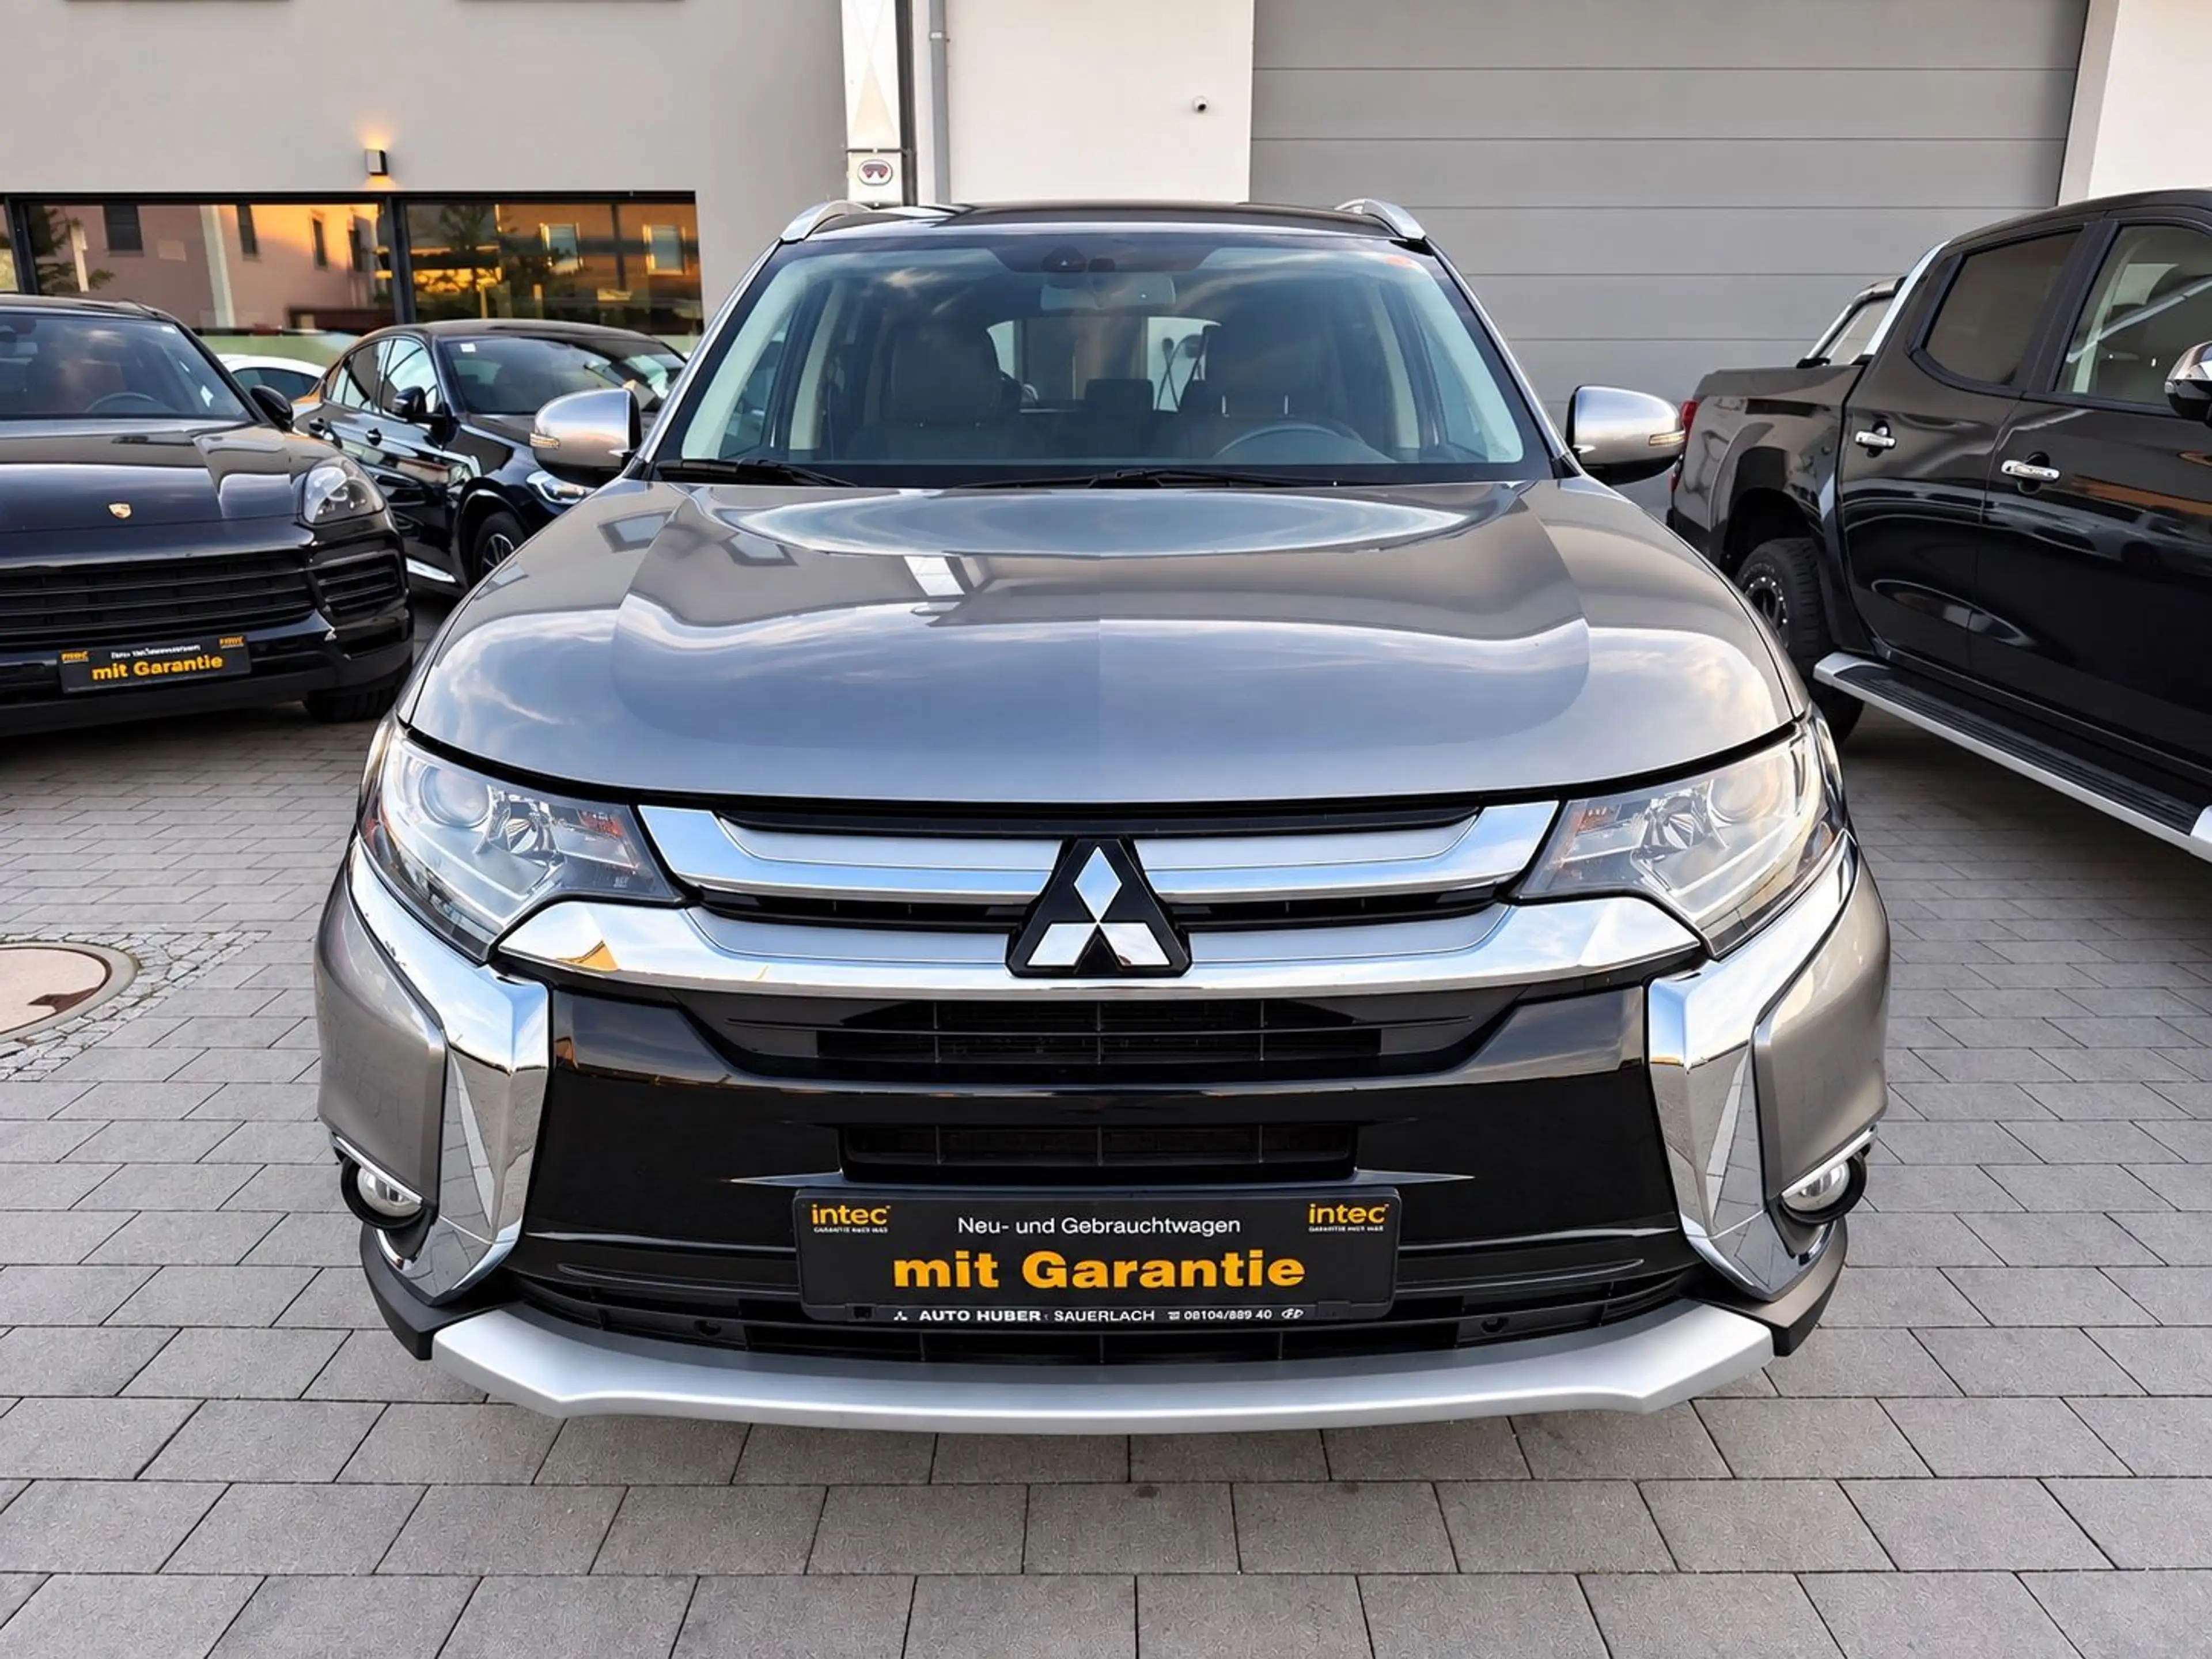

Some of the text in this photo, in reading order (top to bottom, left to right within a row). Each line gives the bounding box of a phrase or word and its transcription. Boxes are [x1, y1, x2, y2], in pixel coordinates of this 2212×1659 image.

[91, 655, 224, 681] mit Garantie
[812, 1203, 888, 1225] intec
[1309, 1203, 1385, 1224] intec
[957, 1216, 1241, 1238] Neu- und Gebrauchtwagen
[894, 1249, 1305, 1289] mit Garantie
[919, 1310, 971, 1321] AUTO
[976, 1310, 1041, 1321] HUBER
[1054, 1310, 1155, 1321] SAUERLACH
[1255, 1309, 1272, 1319] 40
